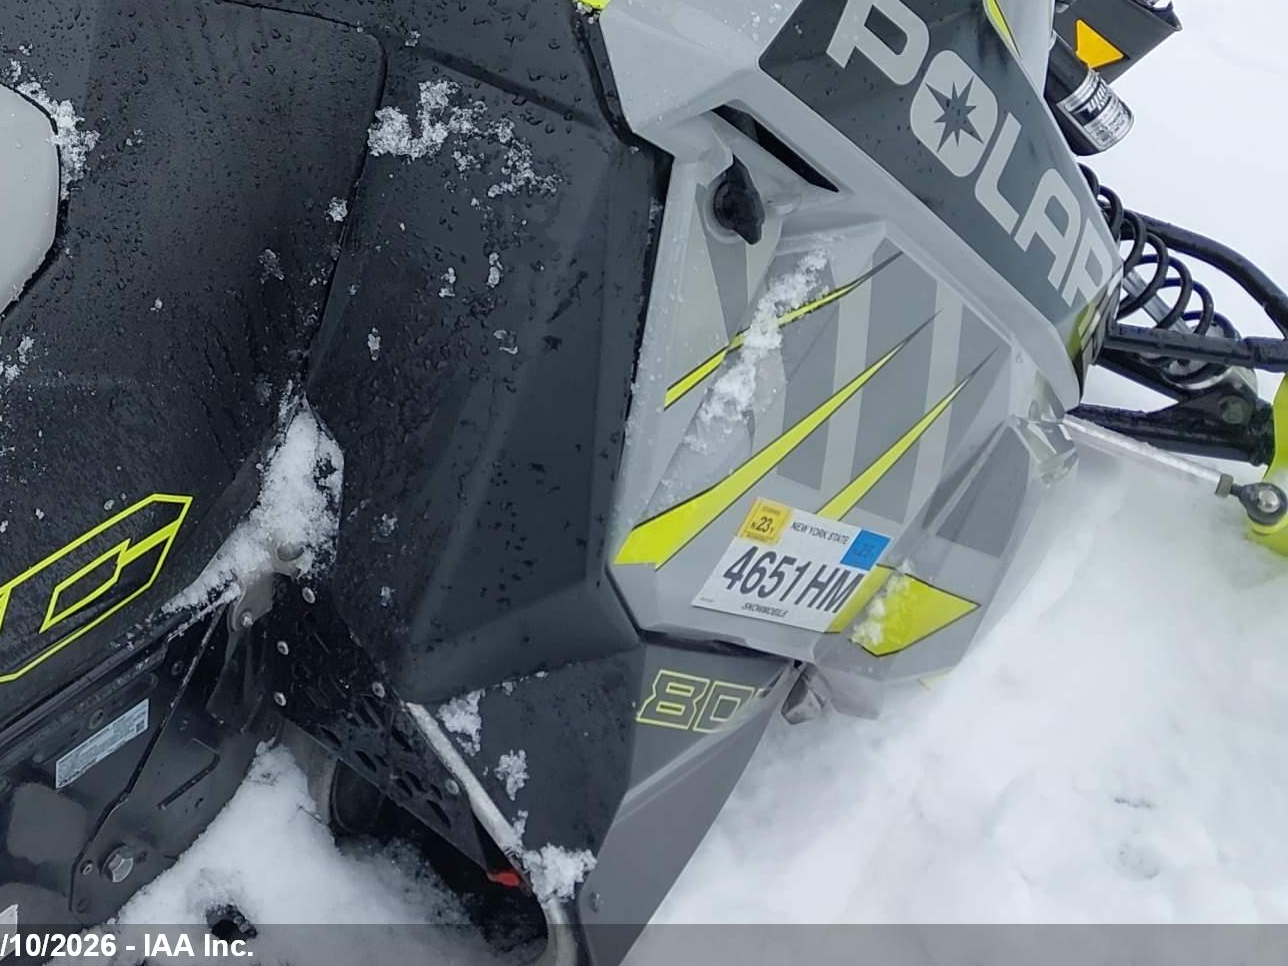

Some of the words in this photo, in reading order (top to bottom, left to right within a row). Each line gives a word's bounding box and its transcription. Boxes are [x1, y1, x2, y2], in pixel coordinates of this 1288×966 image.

[756, 516, 773, 533] 23
[790, 521, 808, 533] NEW
[808, 524, 828, 539] YORK
[827, 530, 851, 545] STATE
